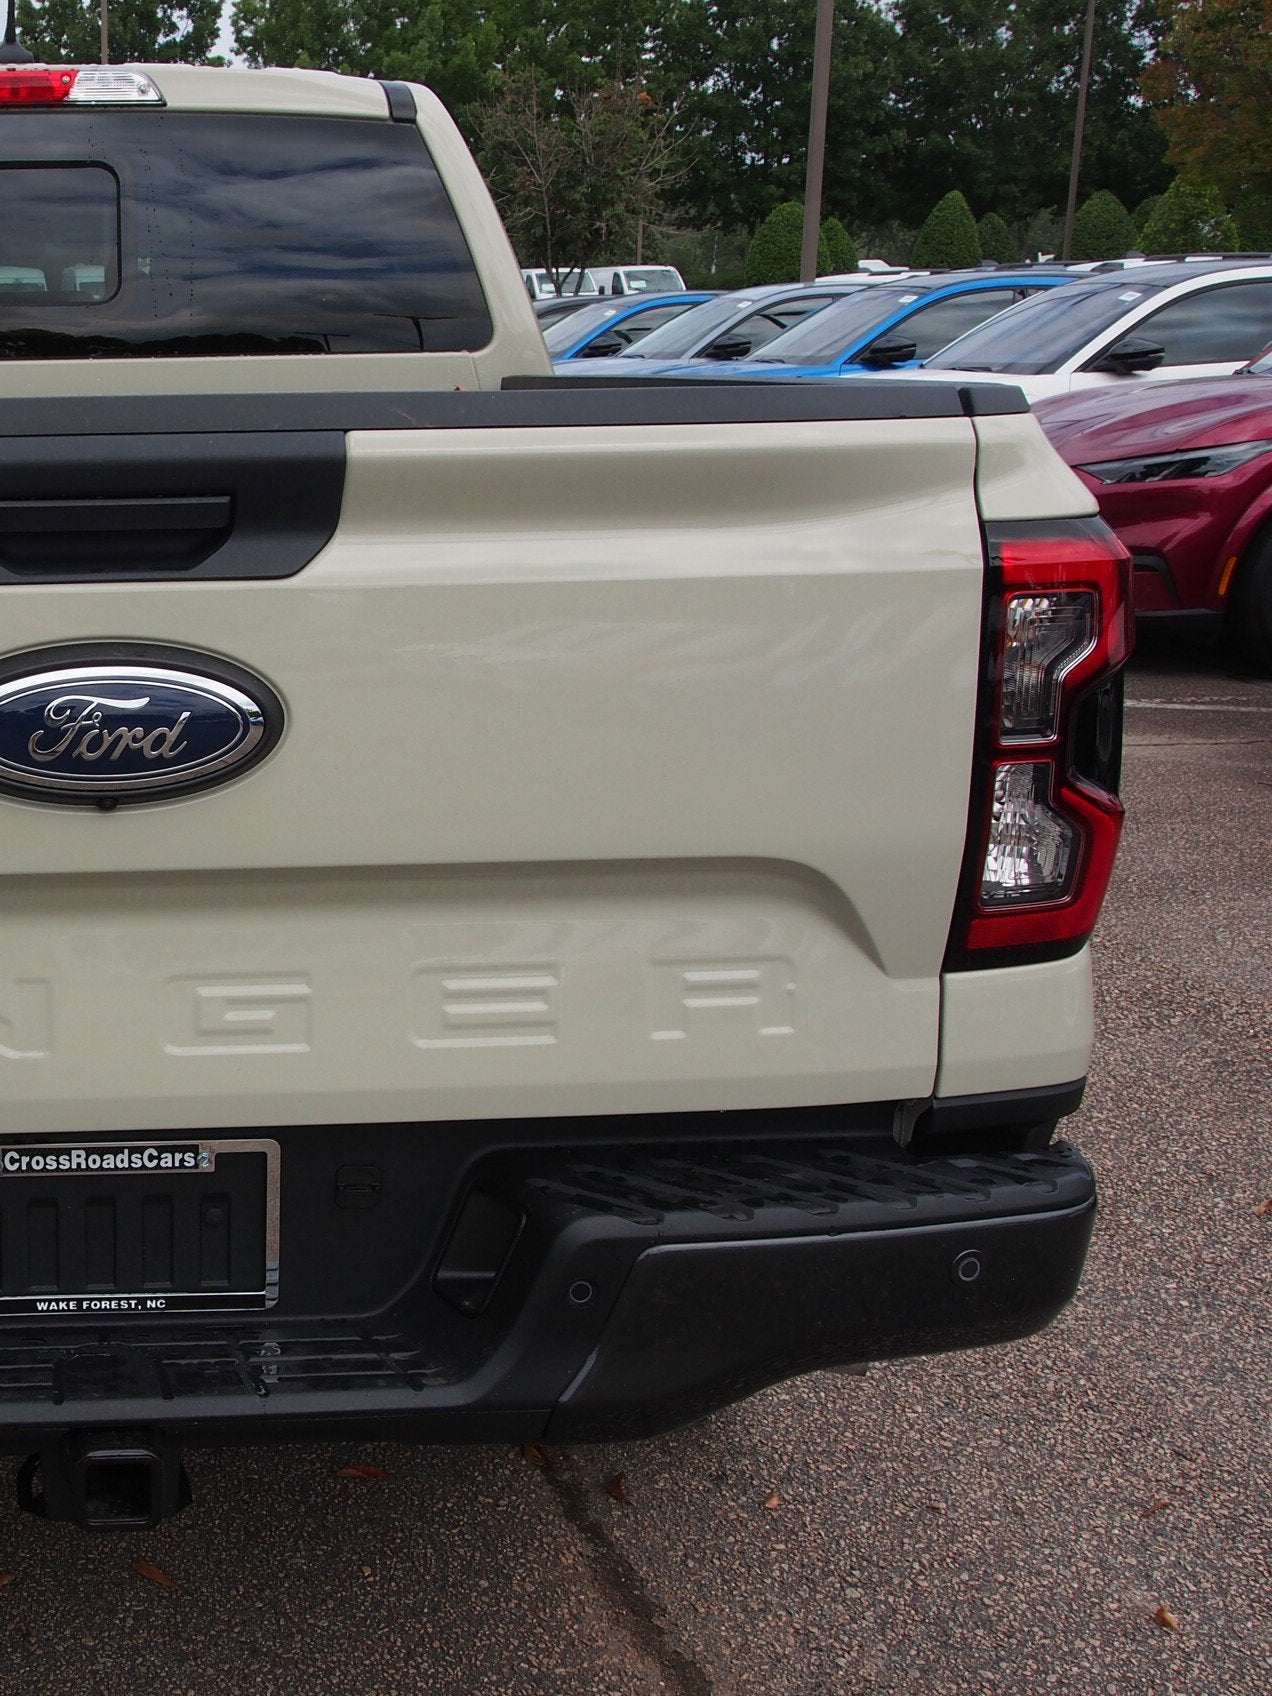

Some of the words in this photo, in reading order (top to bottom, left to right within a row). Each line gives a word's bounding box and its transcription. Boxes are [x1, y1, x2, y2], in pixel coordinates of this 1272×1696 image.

[27, 694, 192, 762] Ford
[3, 1148, 196, 1172] CrossRoadsCars
[36, 1301, 78, 1311] WAKE
[82, 1299, 143, 1311] FOREST,
[146, 1299, 166, 1310] NC
